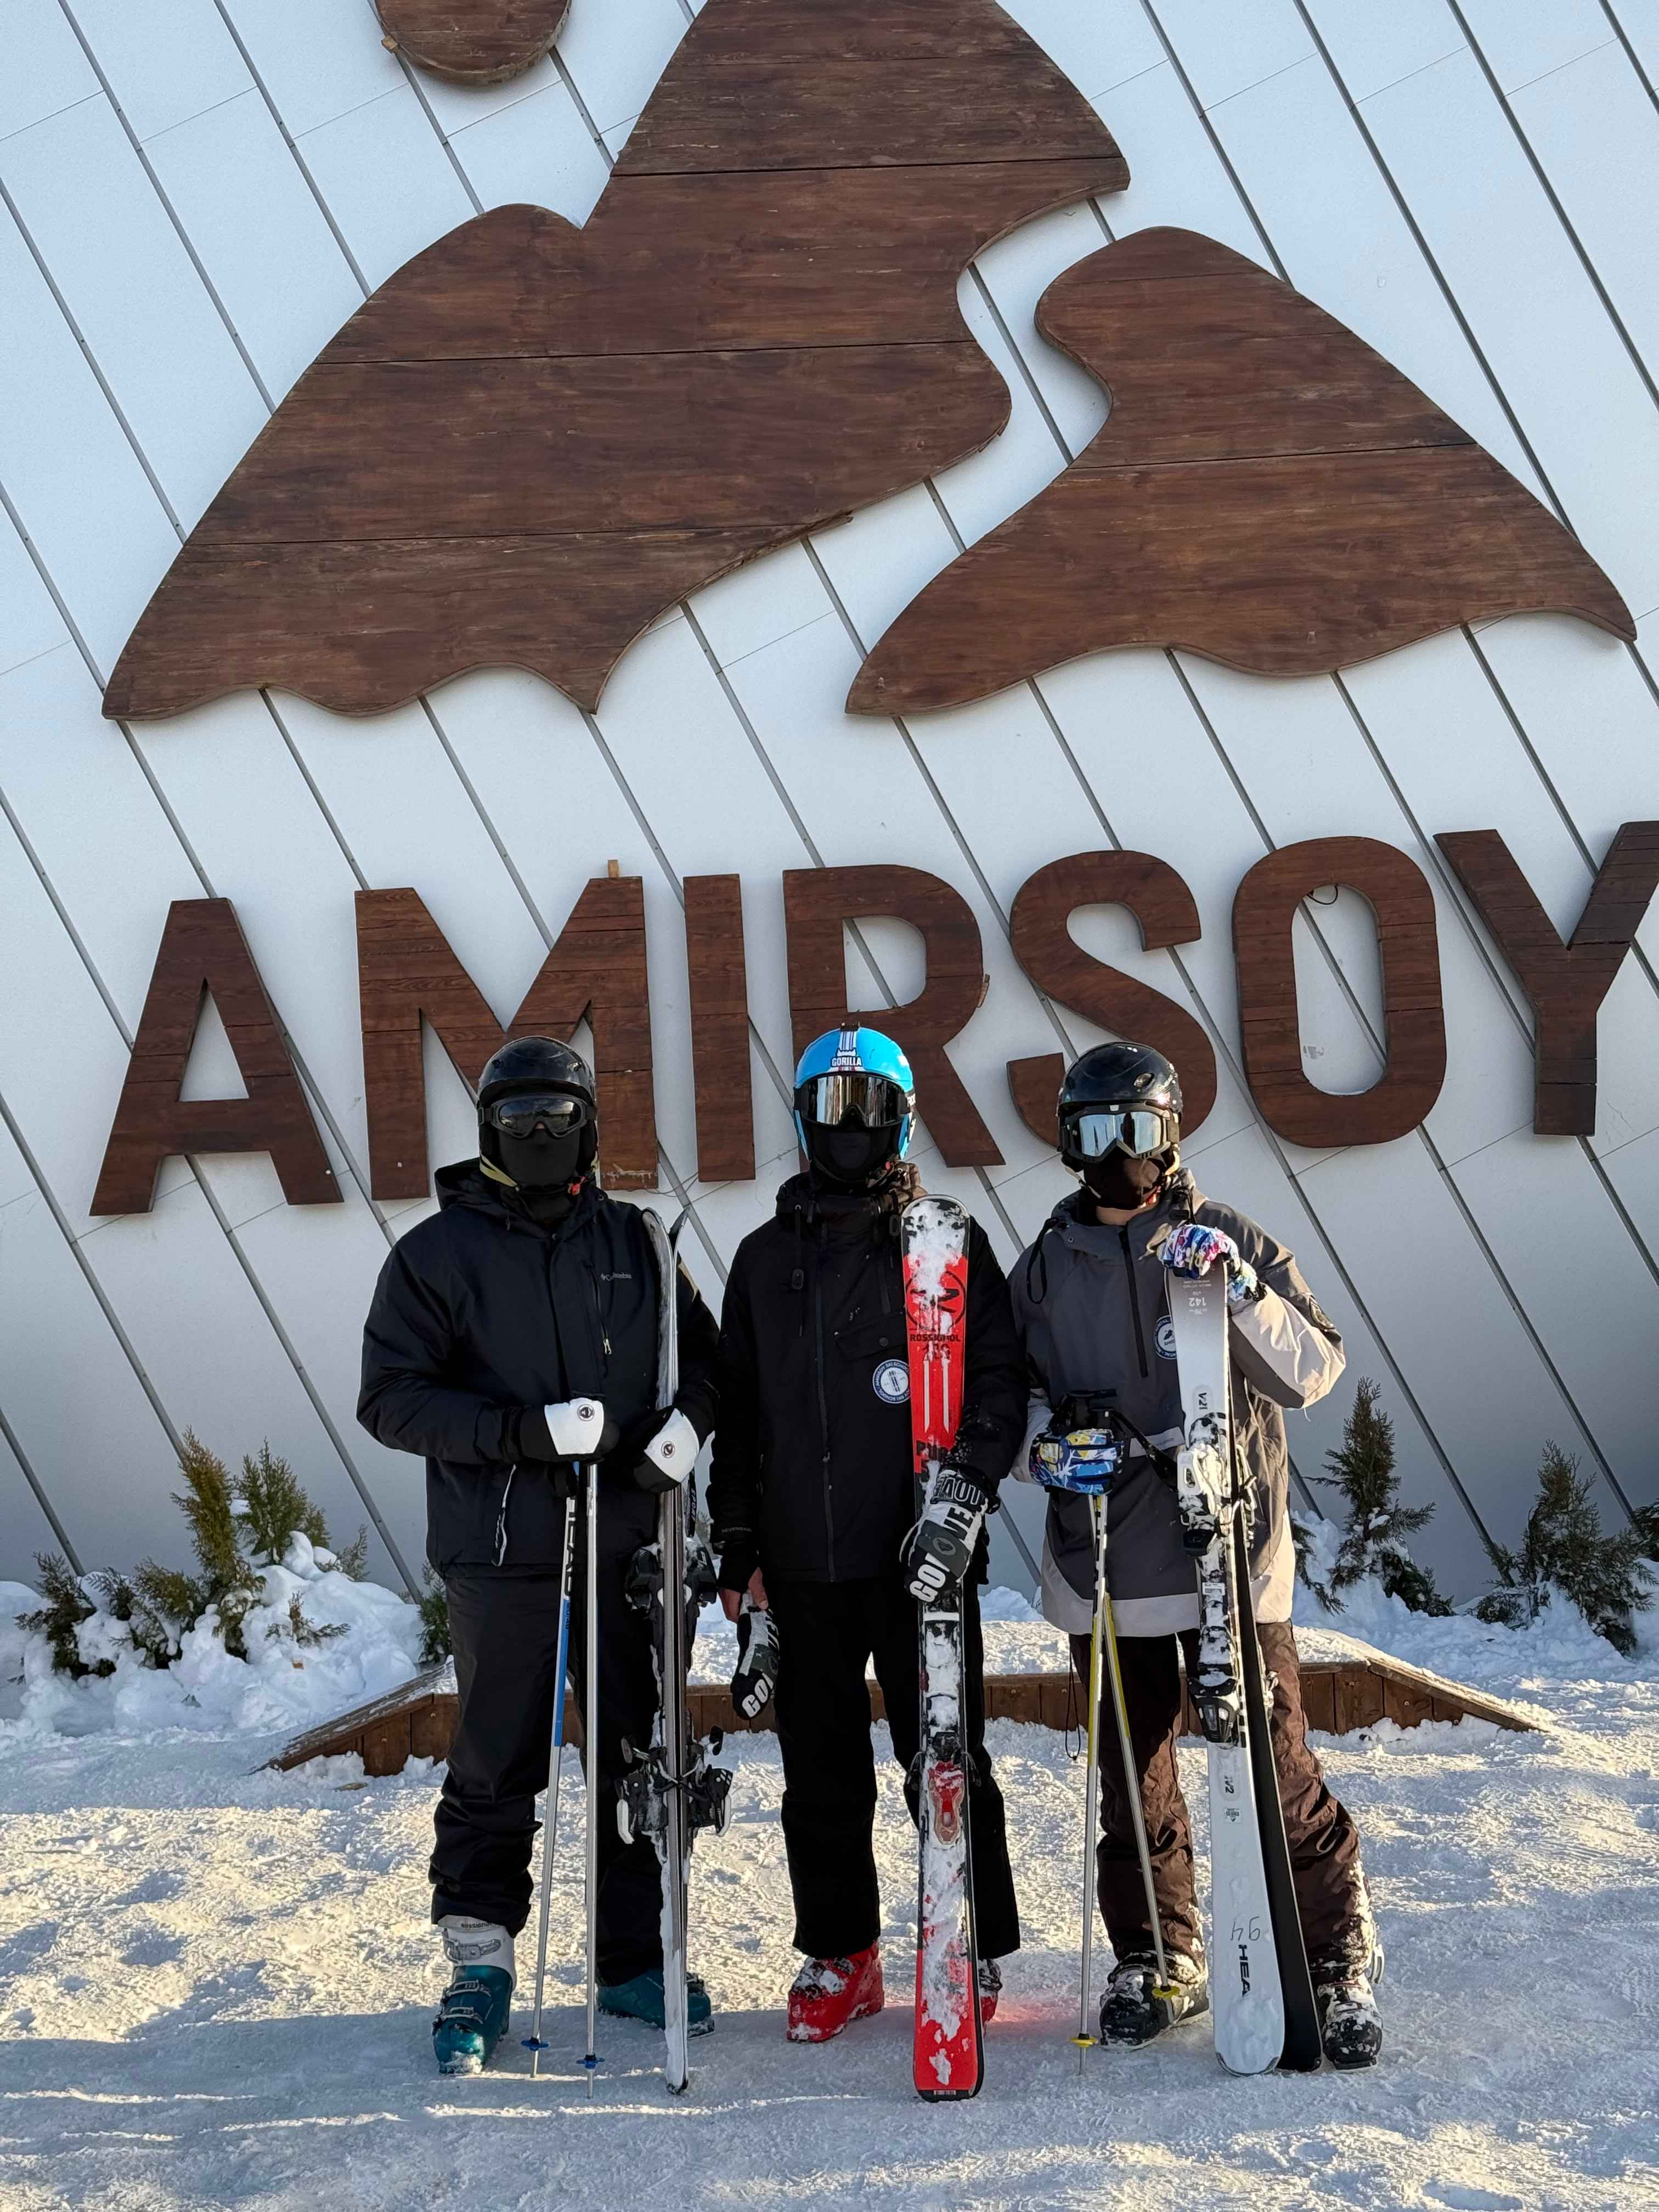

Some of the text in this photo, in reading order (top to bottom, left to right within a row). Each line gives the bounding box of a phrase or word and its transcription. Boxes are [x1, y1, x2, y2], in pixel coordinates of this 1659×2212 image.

[89, 820, 1659, 1217] AMIRSOY
[831, 1057, 862, 1066] GORILLA
[1189, 1297, 1206, 1306] 142
[1231, 1916, 1260, 1941] 94
[1238, 1944, 1250, 1997] HEA
